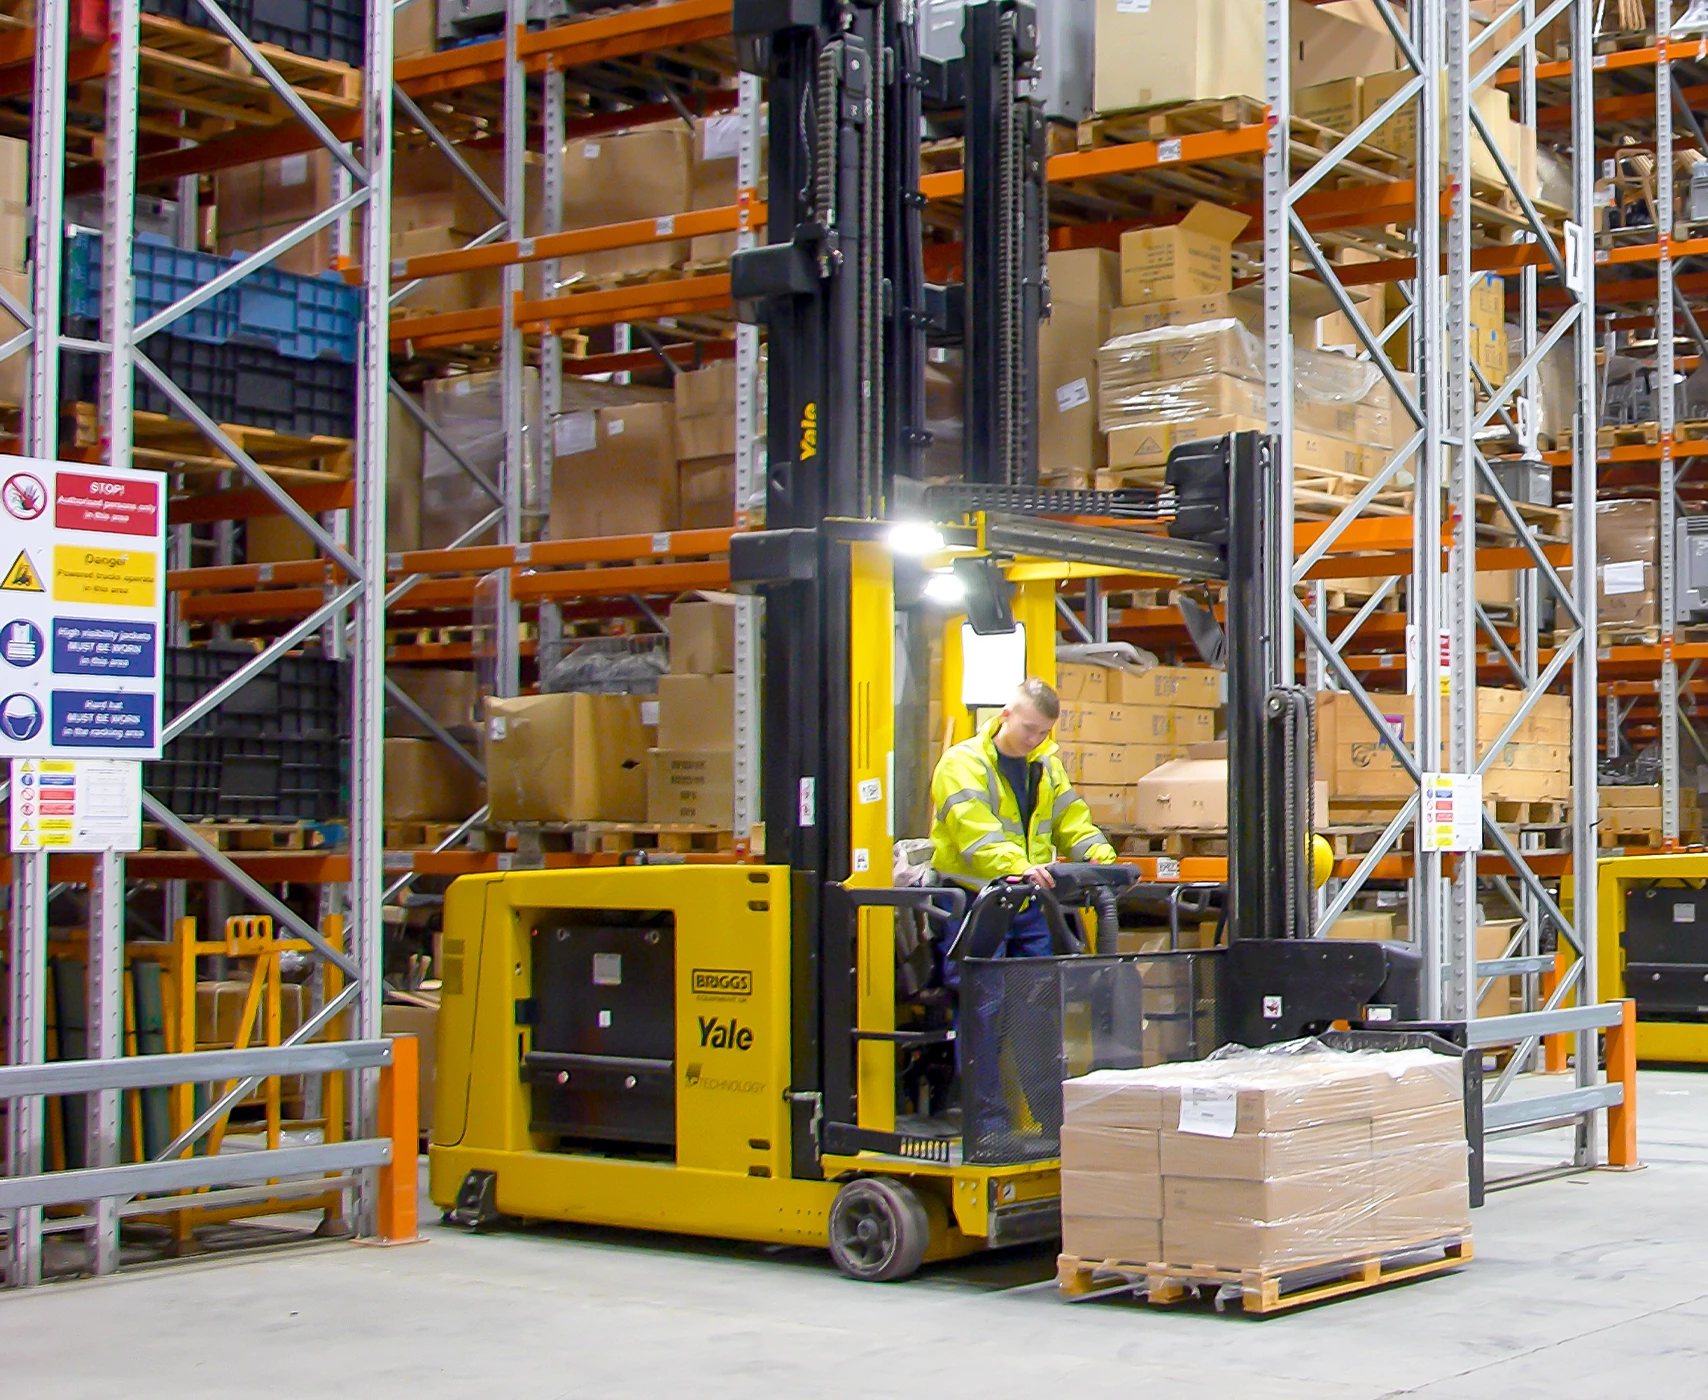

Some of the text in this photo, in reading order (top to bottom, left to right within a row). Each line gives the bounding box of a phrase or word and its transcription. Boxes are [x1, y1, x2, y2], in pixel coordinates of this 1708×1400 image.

[800, 402, 817, 461] Yale
[90, 482, 124, 495] STOP!
[138, 504, 156, 514] only
[94, 512, 110, 522] this
[111, 515, 129, 523] area
[85, 554, 126, 567] Danger
[58, 627, 151, 642] High visibility jackets
[67, 642, 141, 655] MUST BE WORN
[80, 656, 129, 668] in this area
[66, 712, 140, 725] MUST BE WORN
[62, 726, 73, 736] in
[73, 727, 90, 737] the
[123, 730, 145, 739] area
[696, 974, 748, 990] BRIGGS
[698, 1015, 754, 1051] Yale
